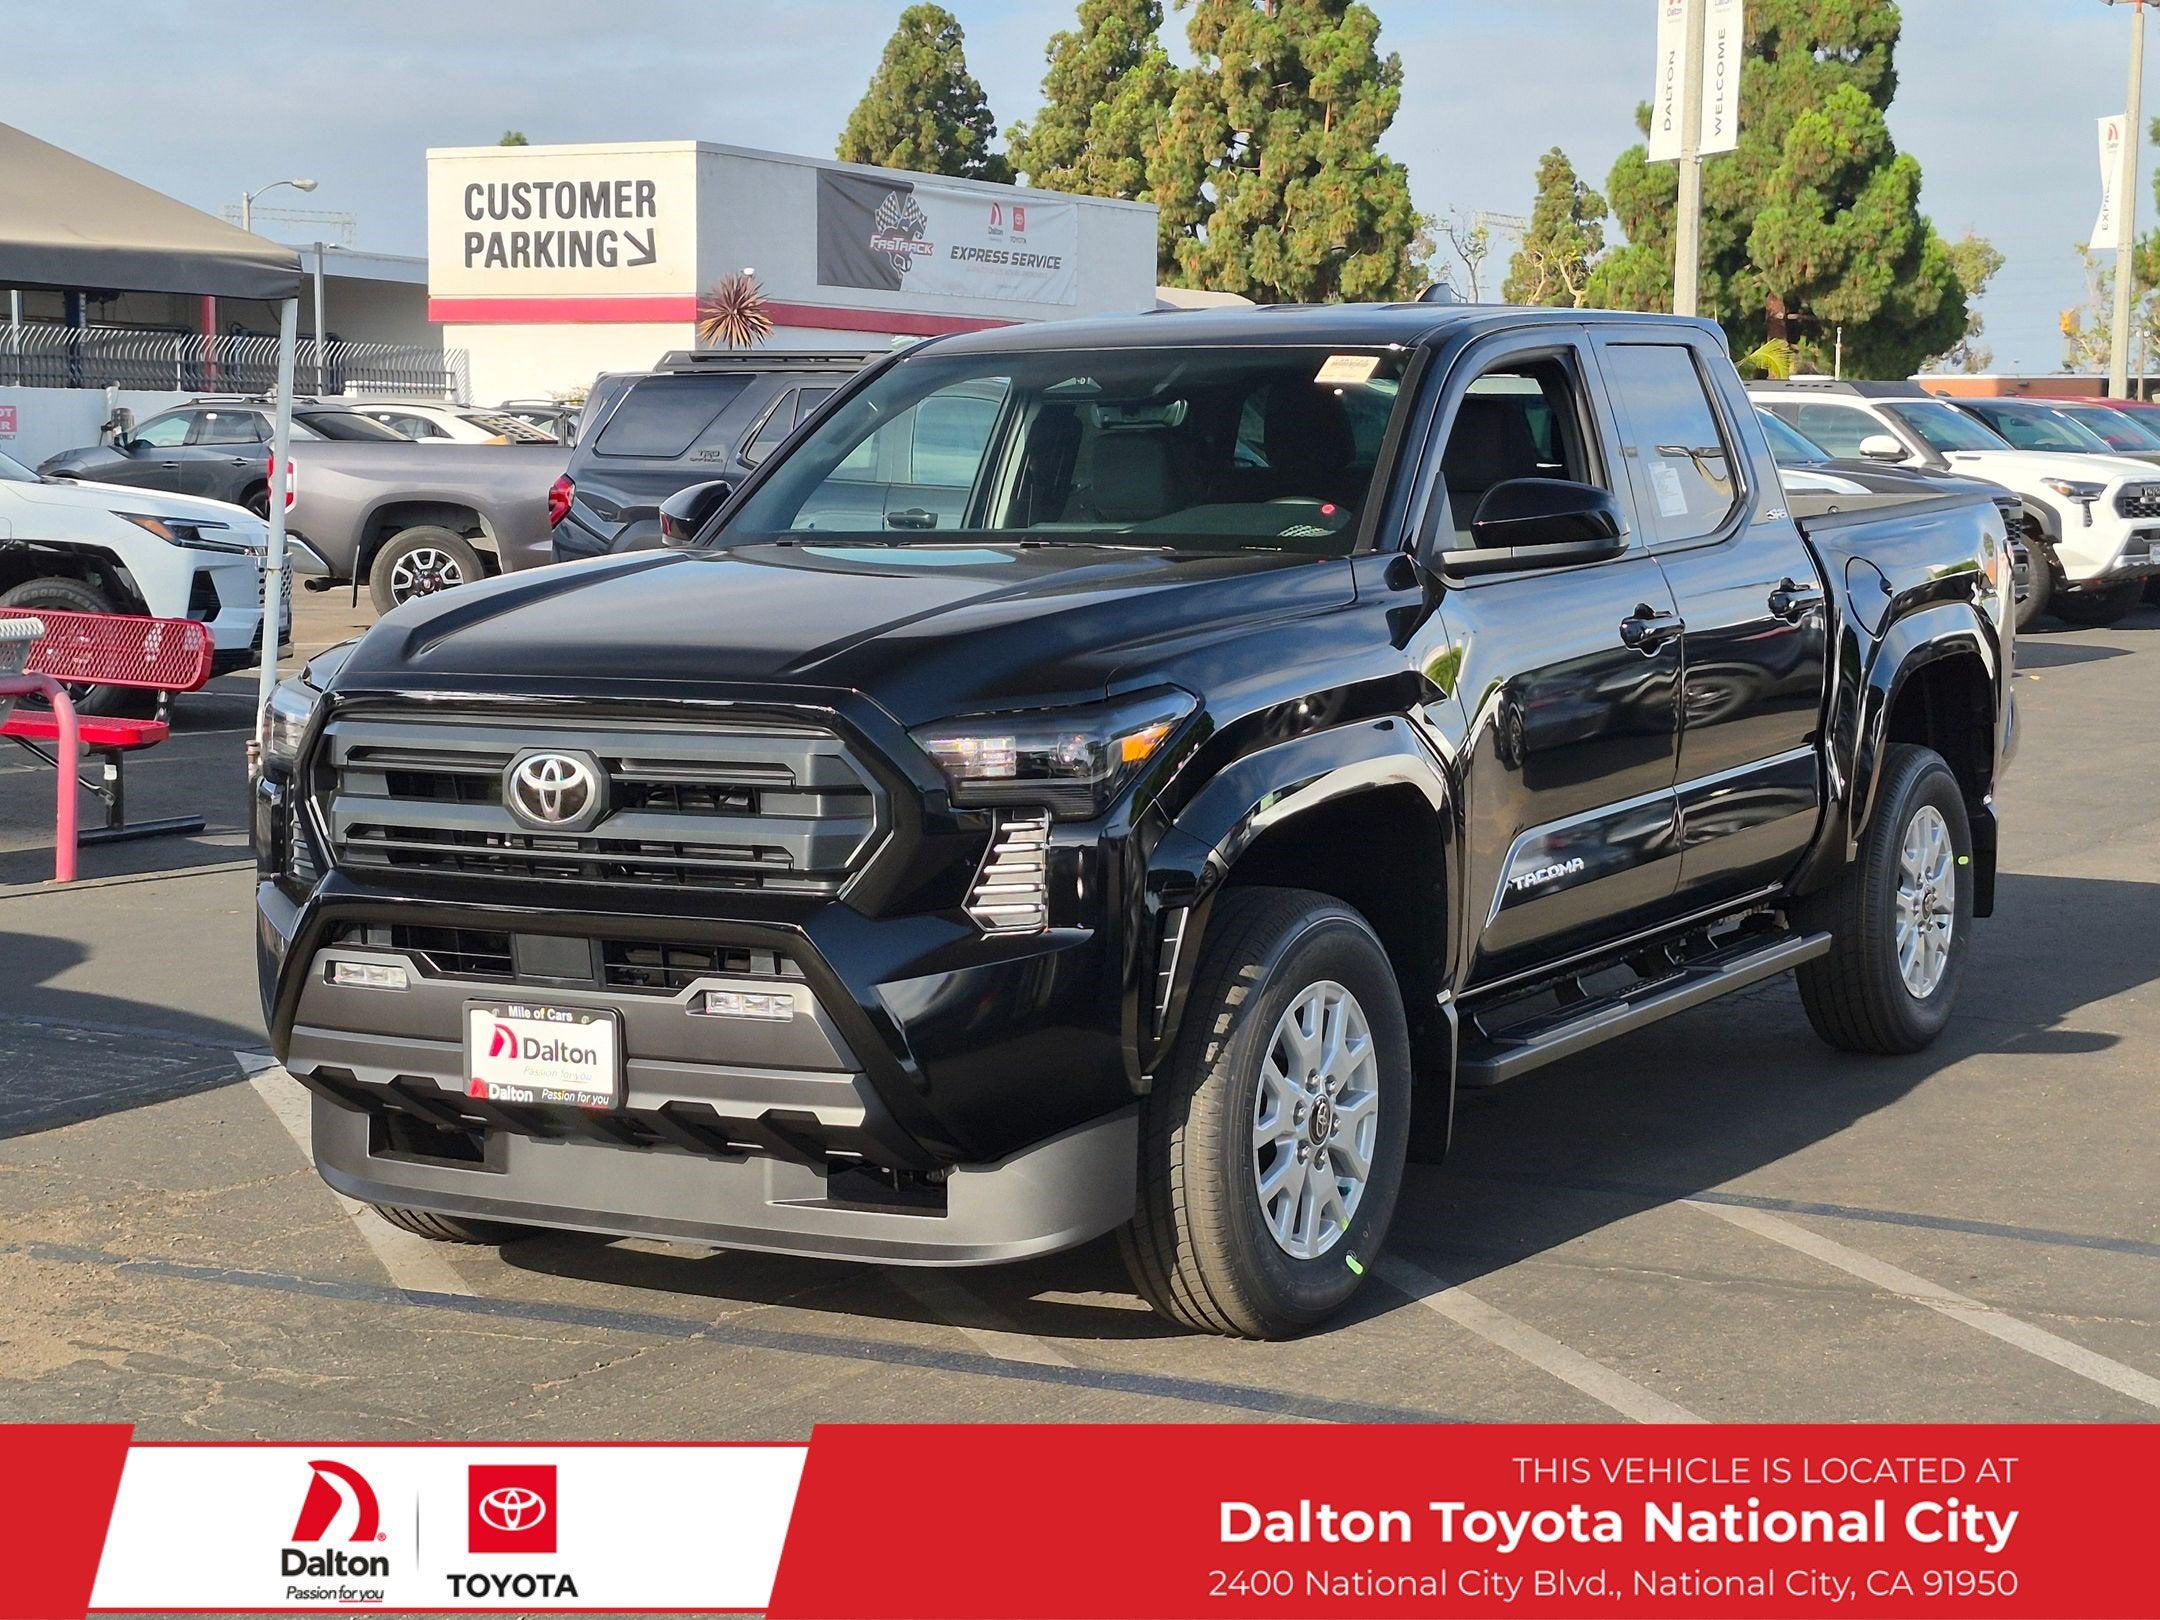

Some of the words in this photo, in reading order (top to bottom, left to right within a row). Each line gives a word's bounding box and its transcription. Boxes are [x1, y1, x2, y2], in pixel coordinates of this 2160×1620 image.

[1664, 50, 1675, 131] DALTON
[1714, 28, 1726, 136] WELCOME
[464, 180, 656, 221] CUSTOMER
[464, 230, 618, 269] PARKING
[950, 245, 1009, 265] EXPRESS
[1010, 250, 1062, 270] SERVICE
[1511, 857, 1585, 891] TACOMA
[508, 1005, 531, 1020] Mile
[533, 1007, 546, 1020] of
[547, 1009, 573, 1022] Cars
[523, 1037, 597, 1065] Dalton
[489, 1084, 533, 1103] Dalton
[541, 1089, 576, 1101] Passion
[577, 1092, 591, 1104] for
[592, 1096, 610, 1107] you
